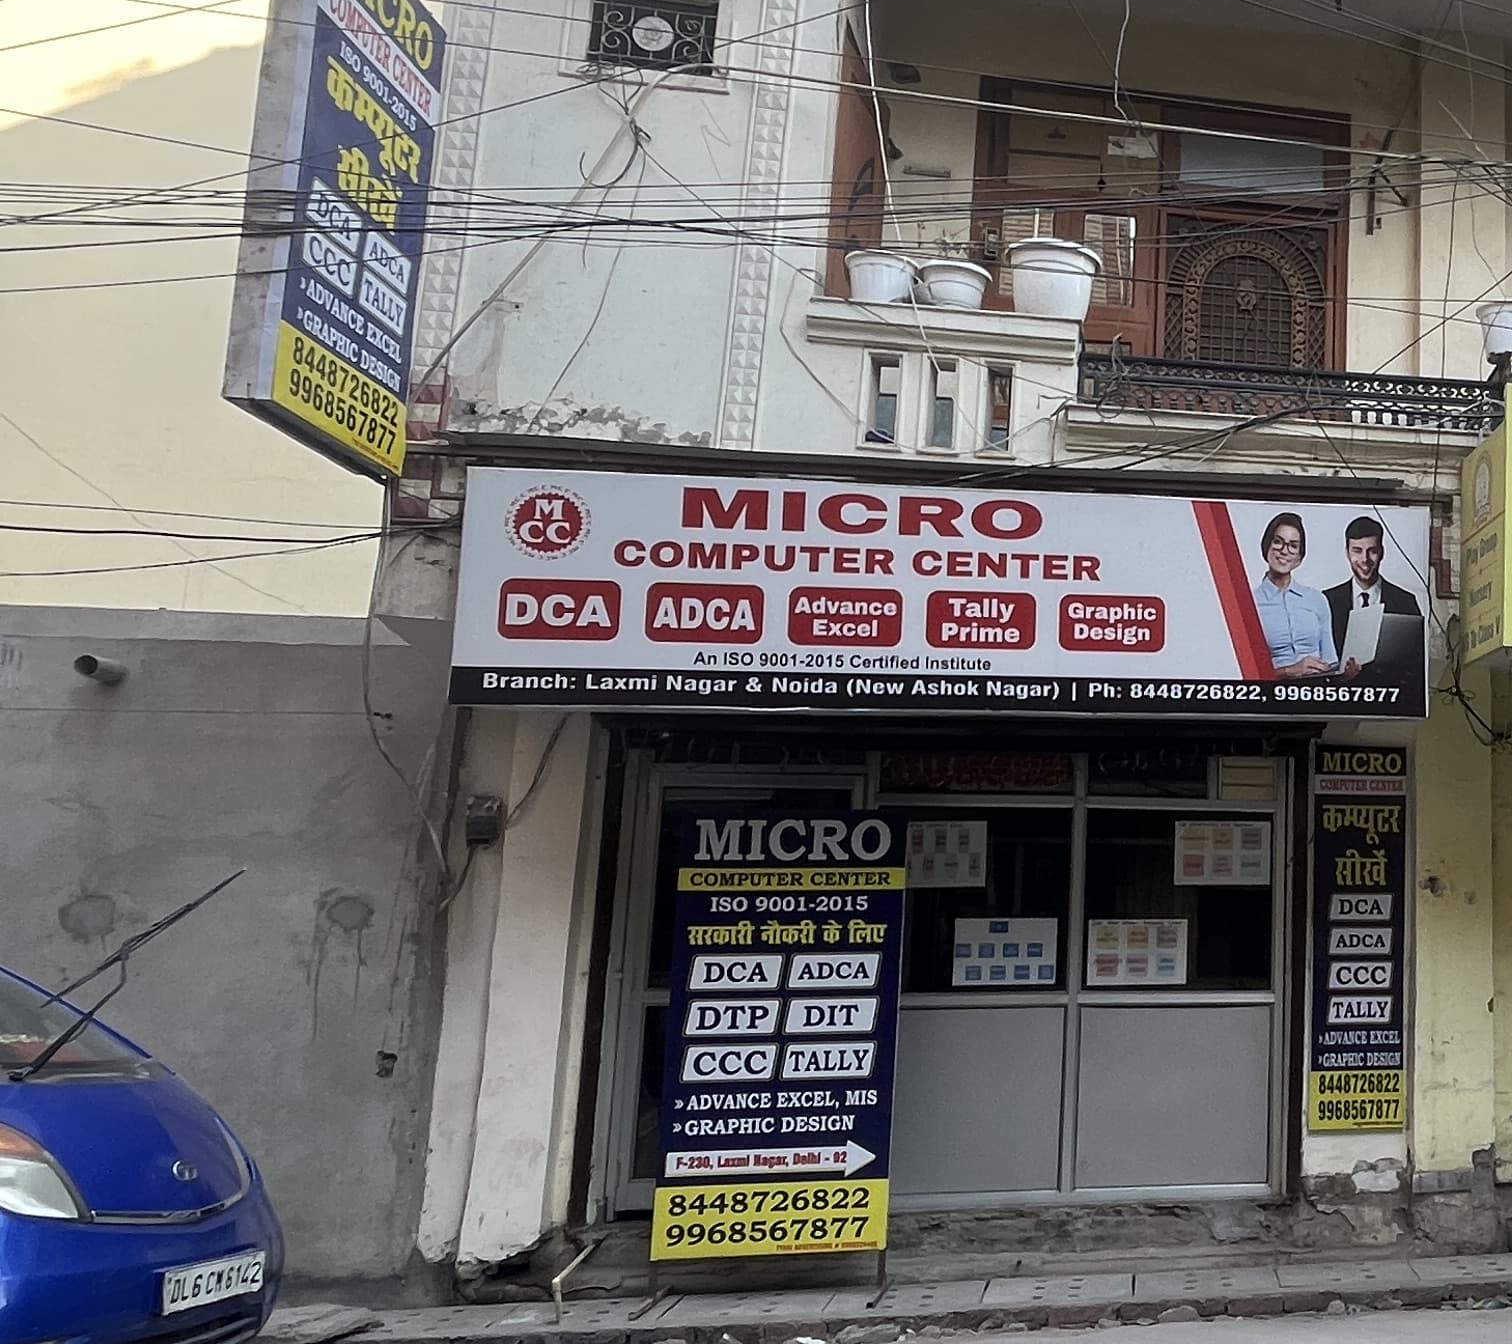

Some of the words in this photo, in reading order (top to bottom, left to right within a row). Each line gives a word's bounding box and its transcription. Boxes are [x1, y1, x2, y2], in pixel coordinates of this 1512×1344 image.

[340, 41, 361, 72] ISO
[393, 55, 432, 114] CENTER
[309, 236, 351, 287] CCC
[364, 279, 404, 328] TALLY
[305, 279, 364, 336] ADVANCE
[366, 322, 402, 364] EXCEL
[303, 309, 358, 363] GRAPHIC
[360, 349, 401, 393] DESIGN
[293, 337, 399, 428] 8448726822
[289, 368, 396, 455] 9968567877
[680, 485, 1044, 540] MICRO
[612, 538, 895, 576] COMPUTER
[911, 549, 1102, 582] CENTER
[504, 593, 612, 628] DCA
[652, 596, 756, 631] ADCA
[794, 595, 897, 617] Advance
[948, 597, 1016, 622] Tally
[1067, 601, 1158, 623] Graphic
[812, 618, 878, 638] Excel
[941, 622, 1021, 644] Prime
[1073, 623, 1151, 645] Design
[693, 651, 717, 666] An
[723, 651, 754, 667] ISO
[759, 653, 845, 668] 9001-2015
[849, 654, 920, 670] Certified
[925, 654, 992, 671] Institute
[482, 672, 577, 690] Branch:
[585, 673, 657, 691] Laxmi
[666, 675, 737, 694] Nagar
[745, 678, 762, 693] &
[771, 678, 838, 695] Noida
[846, 679, 904, 697] (New
[912, 679, 979, 696] Ashok
[986, 681, 1060, 700] Nagar)
[1088, 682, 1123, 699] Ph:
[1129, 682, 1267, 703] 8448726822,
[1274, 687, 1400, 703] 9968567877
[1322, 752, 1401, 773] MICRO
[694, 819, 892, 861] MICRO
[690, 873, 804, 886] COMPUTER
[810, 872, 891, 885] CENTER
[710, 897, 748, 912] ISO
[756, 896, 868, 912] 9001-2015
[1338, 898, 1384, 916] DCA
[688, 920, 755, 945] सरकारी
[760, 919, 816, 945] नौकरी
[822, 920, 842, 944] के
[848, 919, 888, 944] लिए
[1335, 934, 1386, 949] ADCA
[703, 962, 768, 983] DCA
[797, 962, 869, 981] ADCA
[1335, 966, 1387, 985] CCC
[695, 1006, 769, 1030] DTP
[803, 1005, 859, 1027] DIT
[1332, 1001, 1389, 1019] TALLY
[1323, 1031, 1367, 1044] ADVANCE
[1370, 1031, 1400, 1044] EXCEL
[693, 1051, 768, 1076] CCC
[789, 1049, 869, 1072] TALLY
[1323, 1053, 1364, 1067] GRAPHIC
[1366, 1052, 1401, 1066] DESIGN
[1318, 1073, 1399, 1094] 8448726822
[687, 1093, 771, 1111] ADVANCE
[776, 1091, 840, 1109] EXCEL,
[845, 1090, 878, 1106] MIS
[1318, 1099, 1399, 1120] 9968567877
[685, 1117, 775, 1136] GRAPHIC
[780, 1115, 855, 1133] DESIGN
[668, 1188, 869, 1217] 8448726822
[666, 1217, 869, 1247] 9968567877
